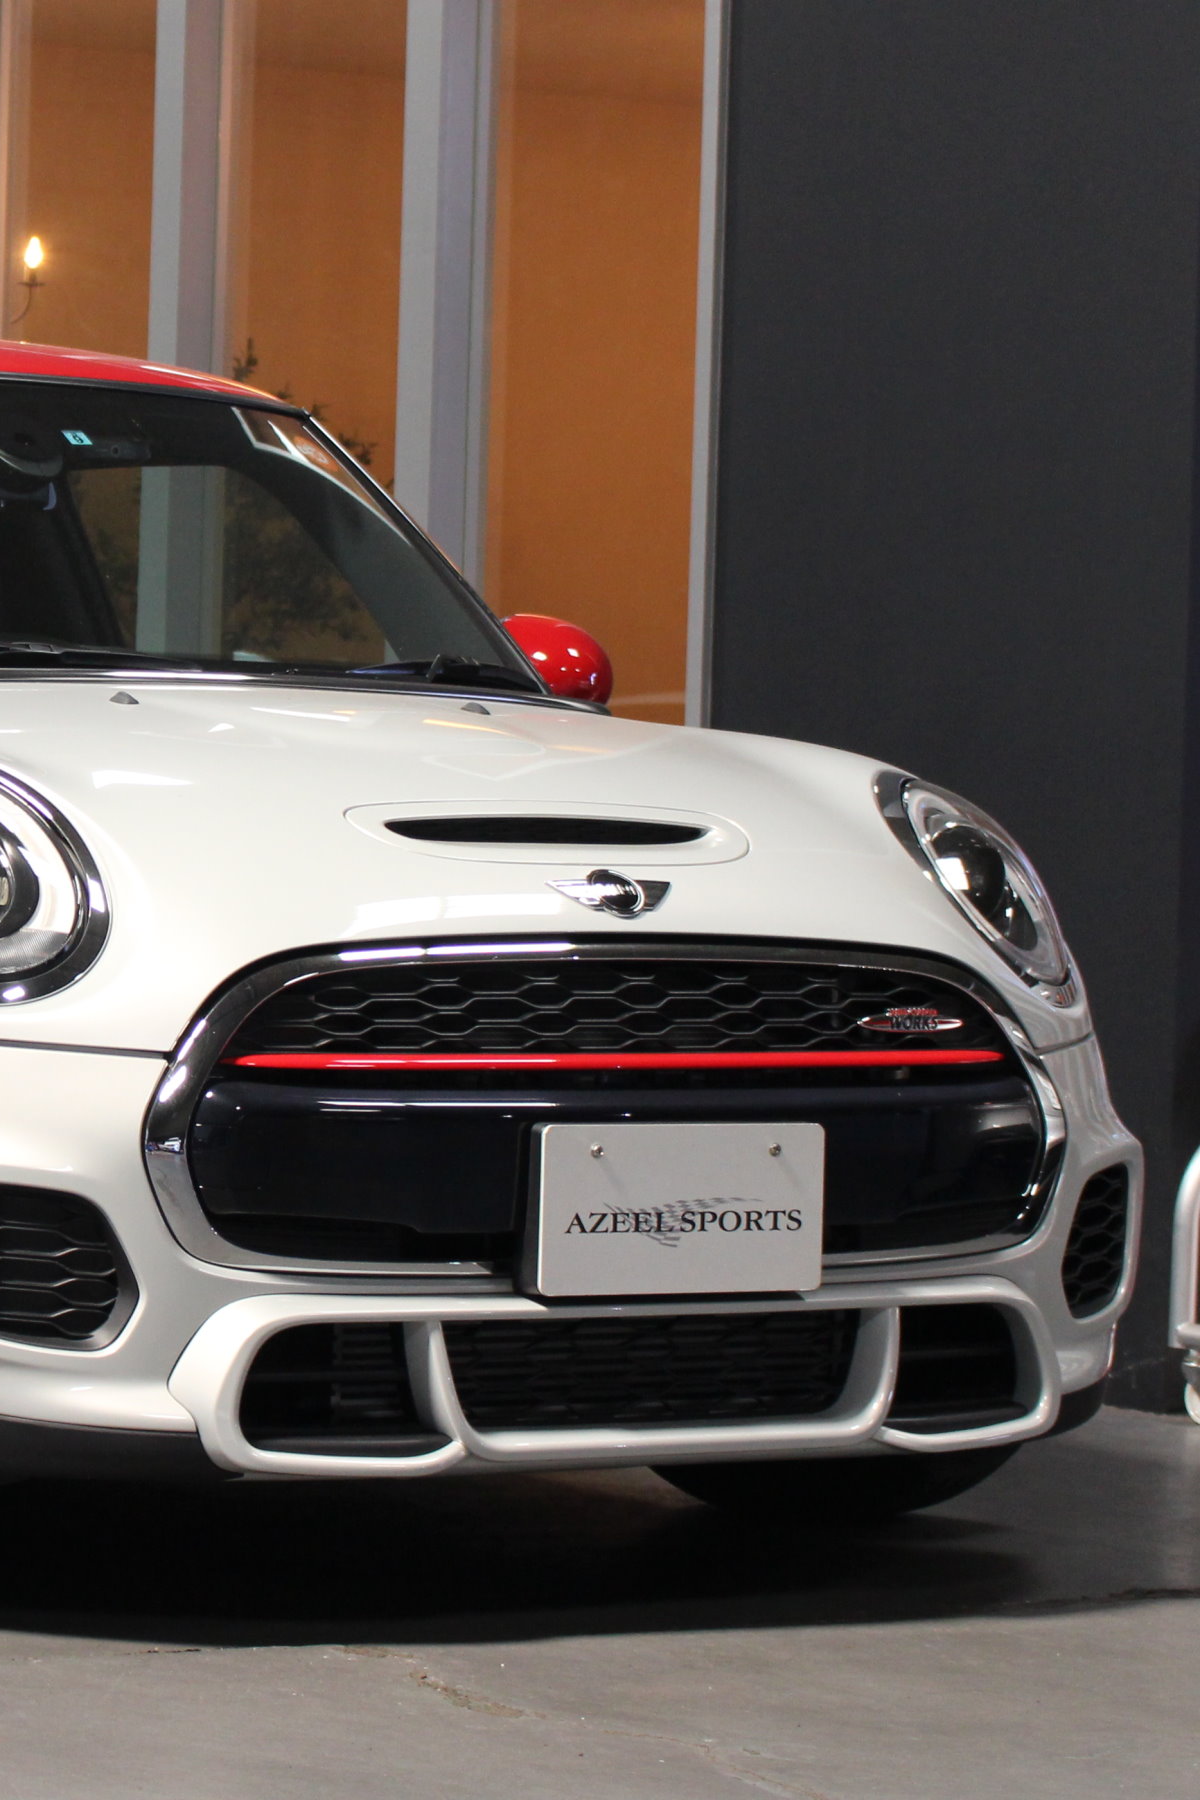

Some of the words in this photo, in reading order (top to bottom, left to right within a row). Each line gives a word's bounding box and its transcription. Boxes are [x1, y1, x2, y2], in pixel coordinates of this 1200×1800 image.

[890, 1015, 938, 1030] WORKS
[564, 1212, 674, 1234] AZEEL
[680, 1209, 802, 1233] SPORTS
